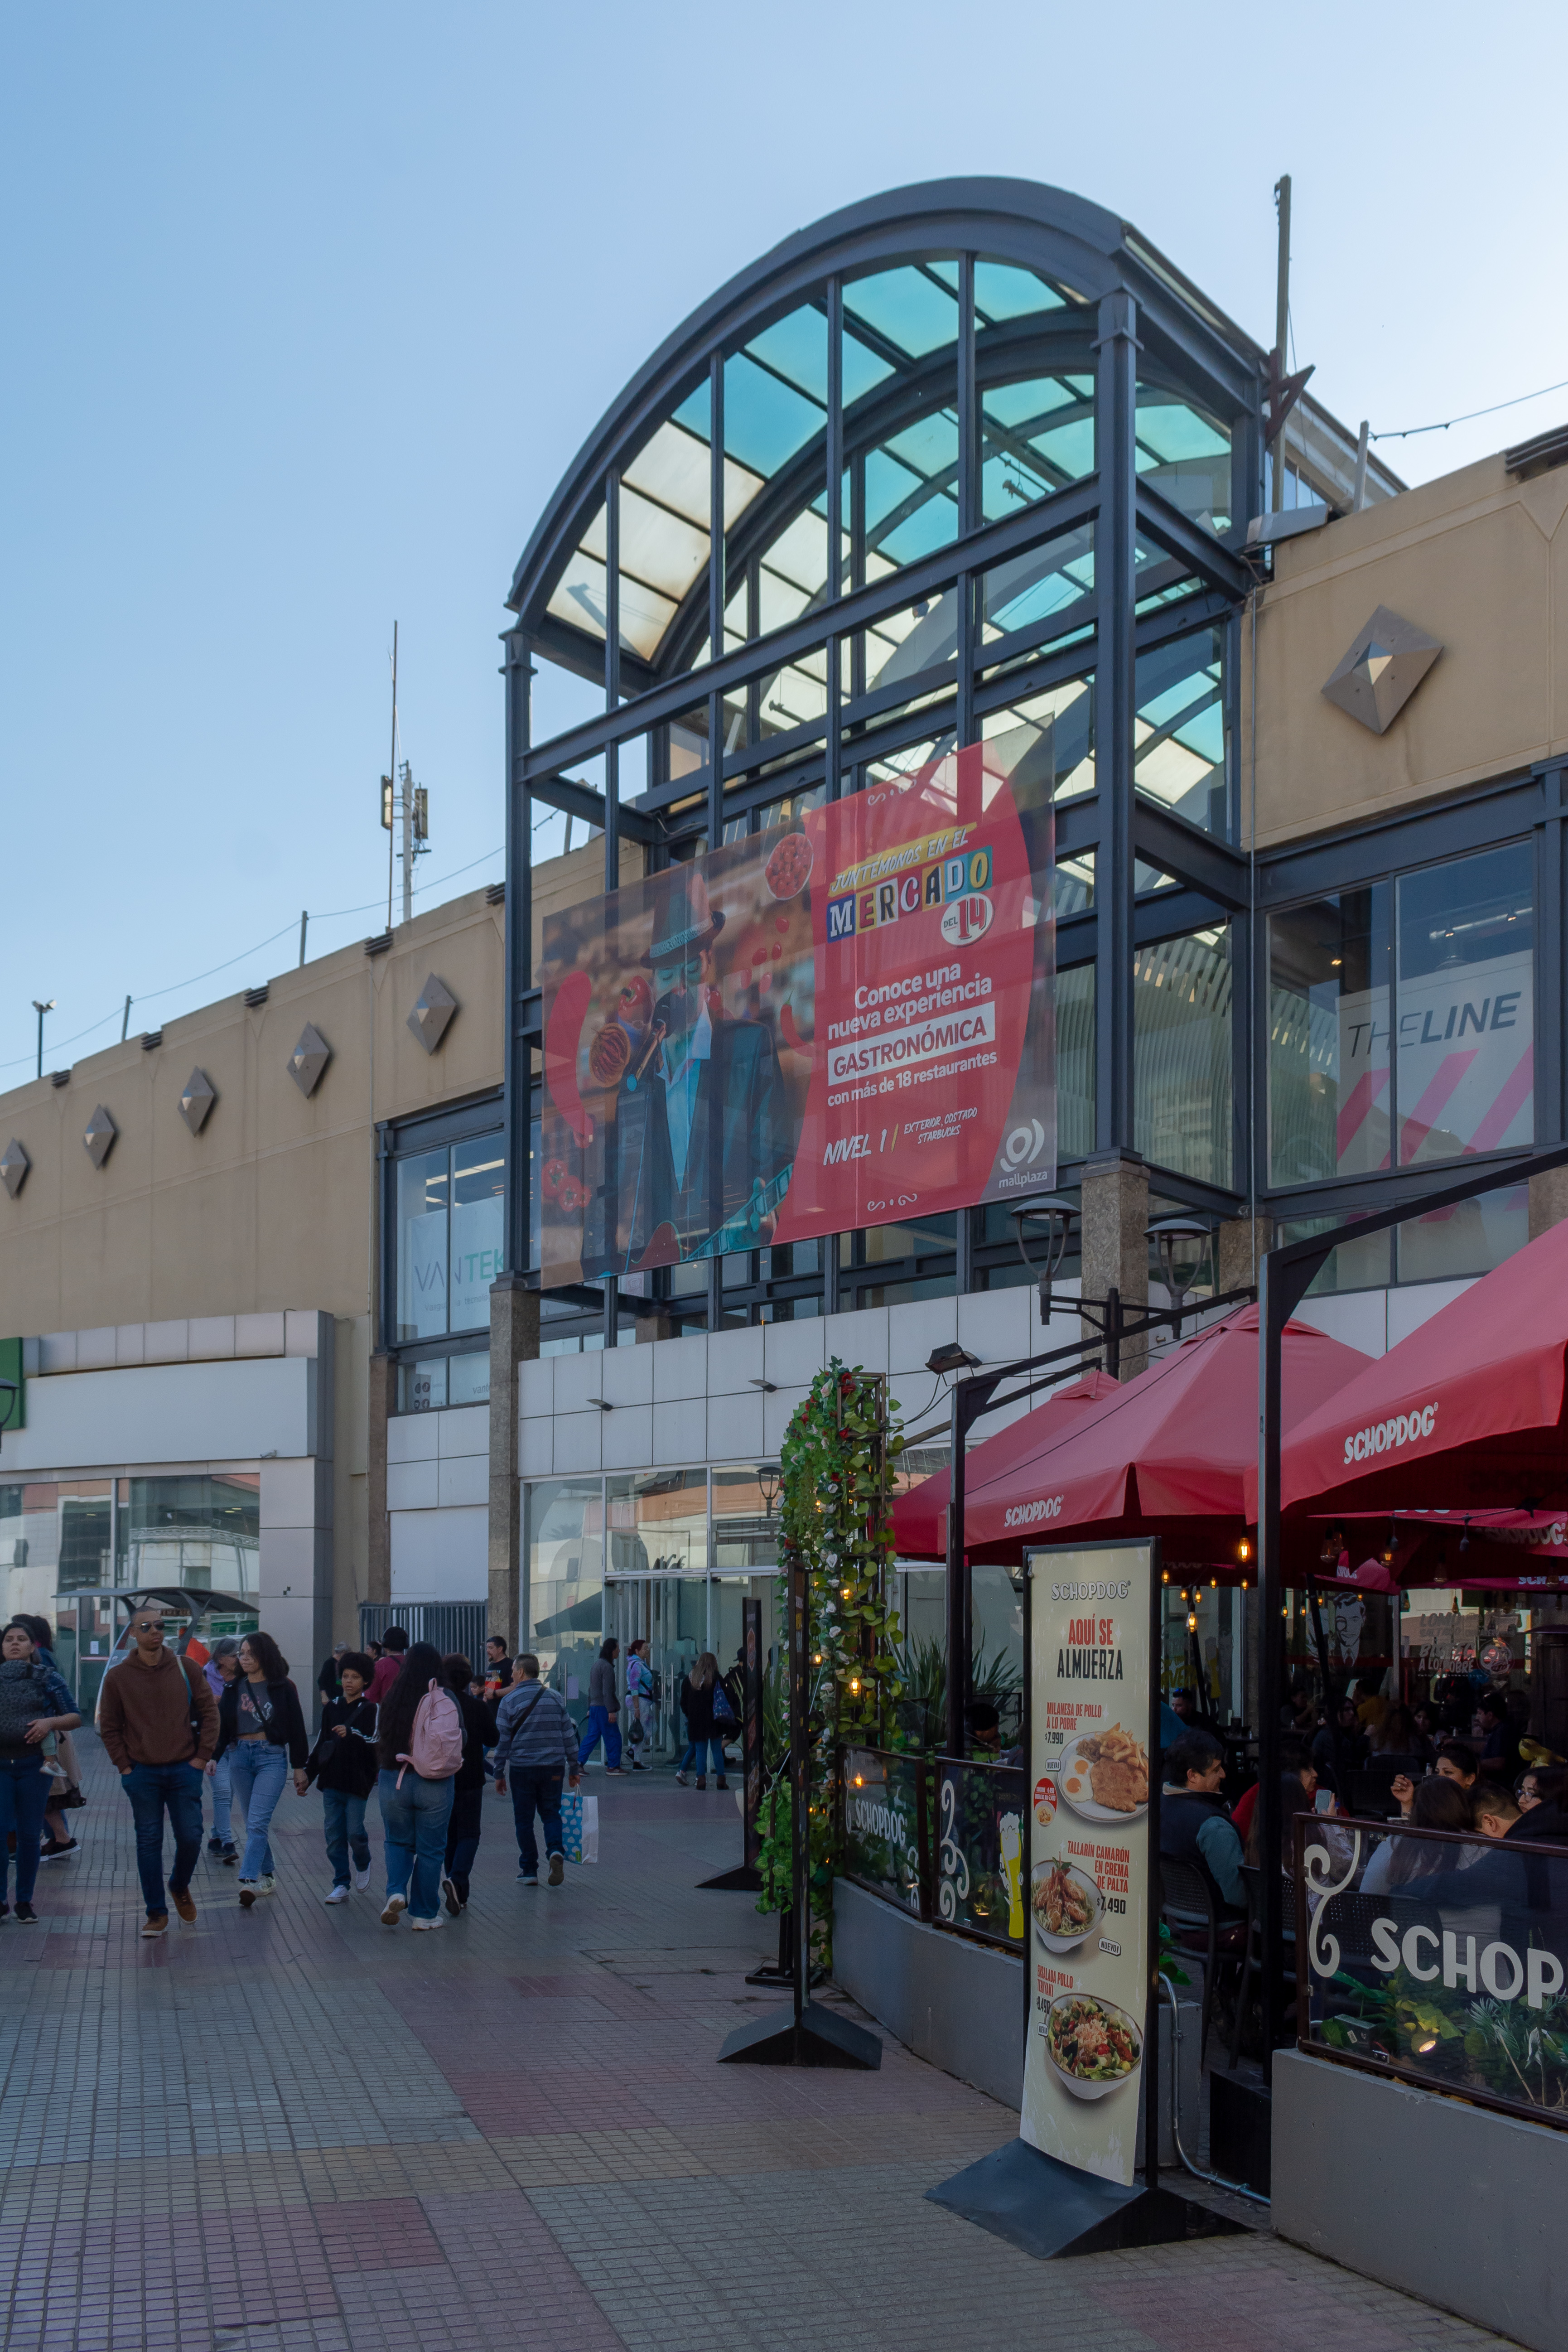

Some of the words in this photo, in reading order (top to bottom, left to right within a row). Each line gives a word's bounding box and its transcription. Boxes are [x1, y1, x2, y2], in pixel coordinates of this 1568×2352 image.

[831, 845, 922, 892] JUNTÉMONOS
[927, 836, 948, 858] EN
[952, 828, 968, 848] EL
[830, 852, 989, 937] MERCADO
[944, 917, 958, 928] DEL
[957, 897, 987, 939] 14
[855, 976, 922, 1009] Conoce
[926, 963, 960, 988] una
[828, 1011, 881, 1040] nueva
[884, 973, 992, 1024] experiencia
[834, 1016, 987, 1077] GASTRONÓMICA
[828, 1092, 849, 1106] con
[851, 1081, 877, 1101] más
[879, 1077, 894, 1093] de
[896, 1071, 912, 1088] 18
[914, 1051, 997, 1084] restaurantes
[904, 1116, 943, 1135] EXTERIOR,
[944, 1107, 977, 1123] COSTADO
[918, 1125, 961, 1144] STARBUCKS
[823, 1134, 872, 1166] NIVEL
[880, 1129, 887, 1152] 1
[999, 1171, 1048, 1188] mallplaza
[1343, 1405, 1435, 1464] SCHOPDOG
[1004, 1496, 1061, 1527] SCHOPDOG
[1052, 1580, 1128, 1600] SCHOPDOG
[1068, 1613, 1095, 1645] AQUÍ
[1099, 1619, 1113, 1645] SE
[1057, 1649, 1123, 1680] ALMUERZA
[1443, 1658, 1474, 1673] OBRE
[1047, 1702, 1074, 1716] MILANESA
[1076, 1704, 1083, 1716] DE
[1084, 1704, 1102, 1718] POLLO
[1047, 1716, 1050, 1728] A
[1052, 1716, 1058, 1729] LO
[1060, 1717, 1077, 1730] POBRE
[1045, 1732, 1063, 1744] $7.990
[856, 1798, 906, 1846] SCHOPDOG
[1068, 1840, 1095, 1857] TALLARÍN
[1096, 1845, 1129, 1863] CAMARÓN
[1095, 1860, 1103, 1874] EN
[1105, 1862, 1129, 1878] CREMA
[1097, 1875, 1105, 1889] DE
[1107, 1877, 1129, 1893] PALTA
[1097, 1896, 1126, 1914] $7.490
[1037, 1964, 1056, 1984] ENSALADA
[1057, 1972, 1073, 1989] POLLO
[1037, 1979, 1053, 1997] TERIYAKI
